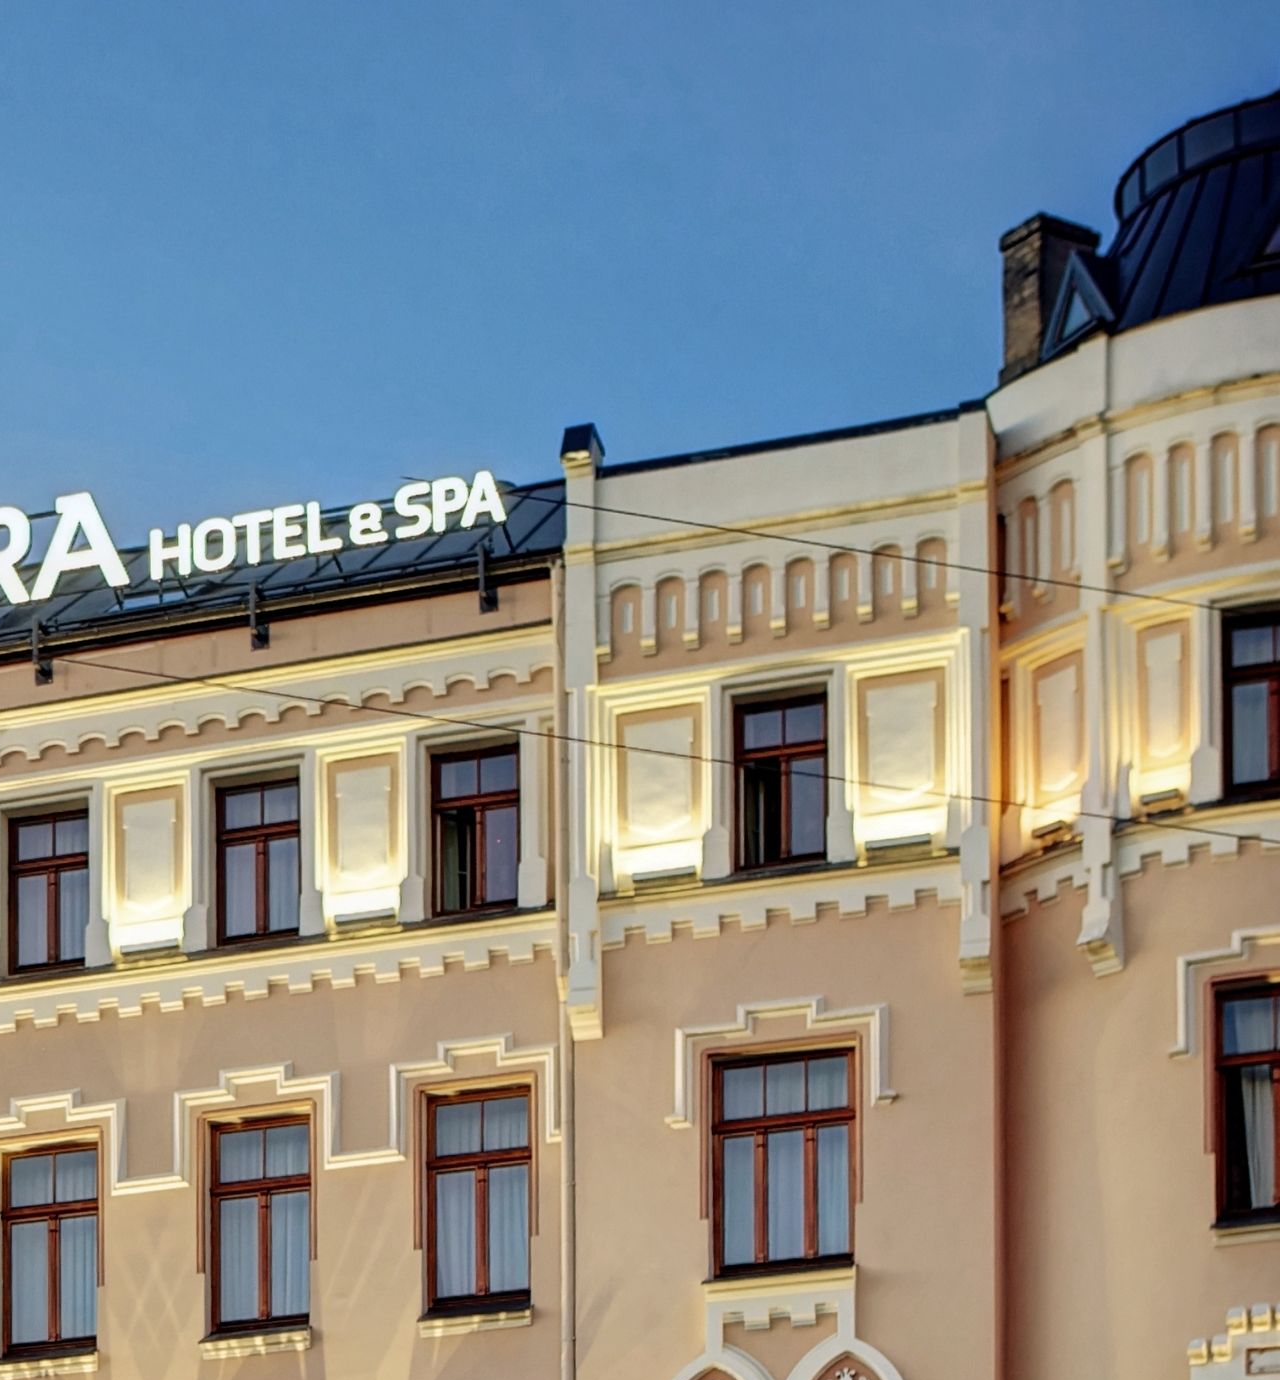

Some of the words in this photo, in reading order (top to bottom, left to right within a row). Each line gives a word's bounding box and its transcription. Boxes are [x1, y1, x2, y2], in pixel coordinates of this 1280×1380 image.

[149, 500, 345, 581] HOTEL
[348, 502, 389, 546] &
[393, 470, 508, 540] SPA
